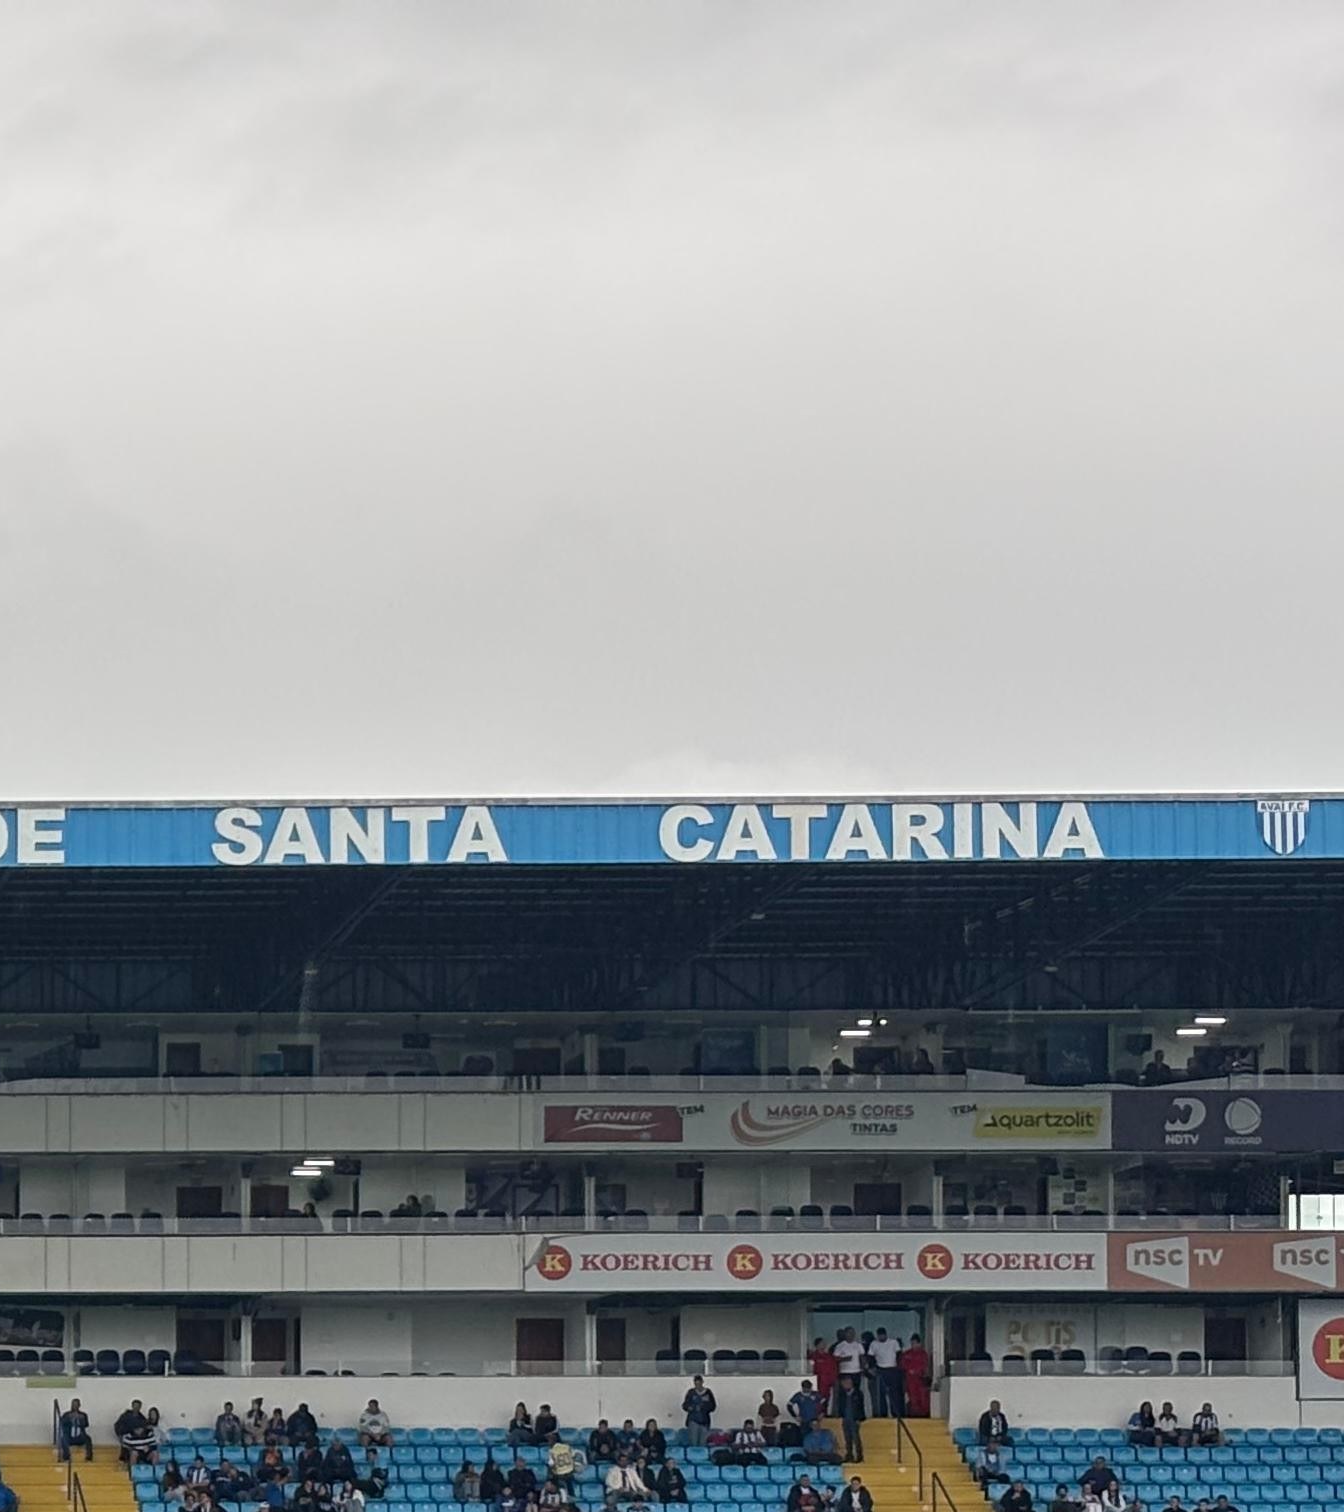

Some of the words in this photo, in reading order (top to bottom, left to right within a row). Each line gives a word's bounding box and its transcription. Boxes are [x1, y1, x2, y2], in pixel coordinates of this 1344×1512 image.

[211, 805, 508, 867] SANTA
[657, 803, 1106, 864] CATARINA
[574, 1106, 653, 1121] RENNER
[767, 1104, 819, 1117] MAGIA
[823, 1104, 857, 1117] DAS
[862, 1104, 914, 1117] CORES
[999, 1110, 1095, 1129] quartzolit
[851, 1122, 898, 1134] TINTAS
[1165, 1134, 1200, 1145] NDTV
[580, 1253, 713, 1272] KOERICH
[771, 1252, 905, 1272] KOERICH
[962, 1252, 1095, 1271] KOERICH
[1133, 1247, 1184, 1266] nsc
[1193, 1248, 1224, 1266] TV
[1280, 1247, 1330, 1266] nsc
